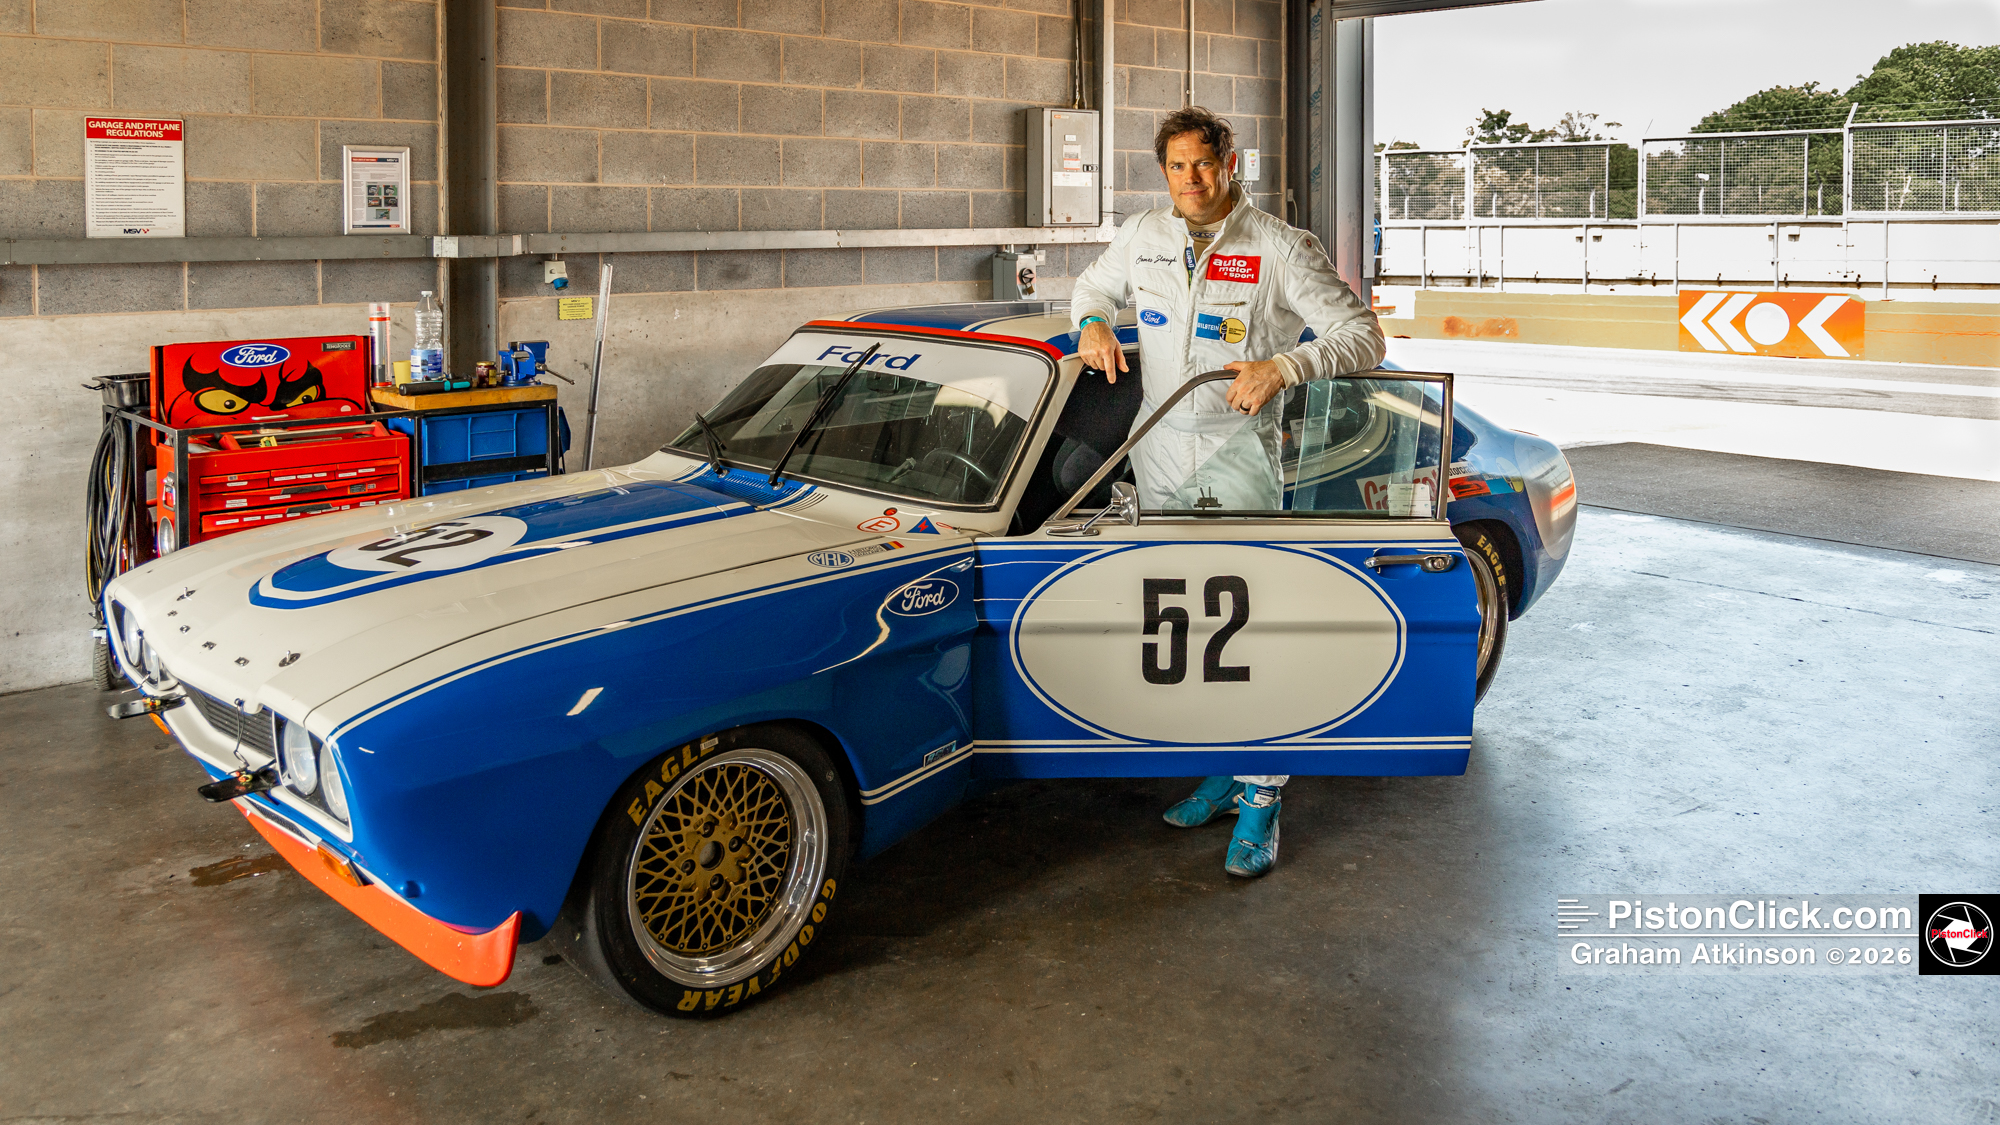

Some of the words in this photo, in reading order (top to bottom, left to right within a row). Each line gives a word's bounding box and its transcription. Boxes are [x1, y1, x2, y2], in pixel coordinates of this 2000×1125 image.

[88, 121, 123, 129] GARAGE
[125, 122, 143, 130] AND
[145, 122, 157, 130] PIT
[158, 123, 180, 131] LANE
[106, 129, 163, 138] REGULATIONS
[1212, 258, 1247, 267] auto
[1218, 266, 1252, 274] motor
[1143, 311, 1161, 324] Ford
[234, 346, 277, 364] Ford
[816, 345, 922, 371] Ford
[358, 522, 494, 568] 52
[813, 552, 848, 567] MRL
[1477, 534, 1507, 587] EAGLE
[901, 583, 945, 612] Ford
[1142, 575, 1250, 685] 52
